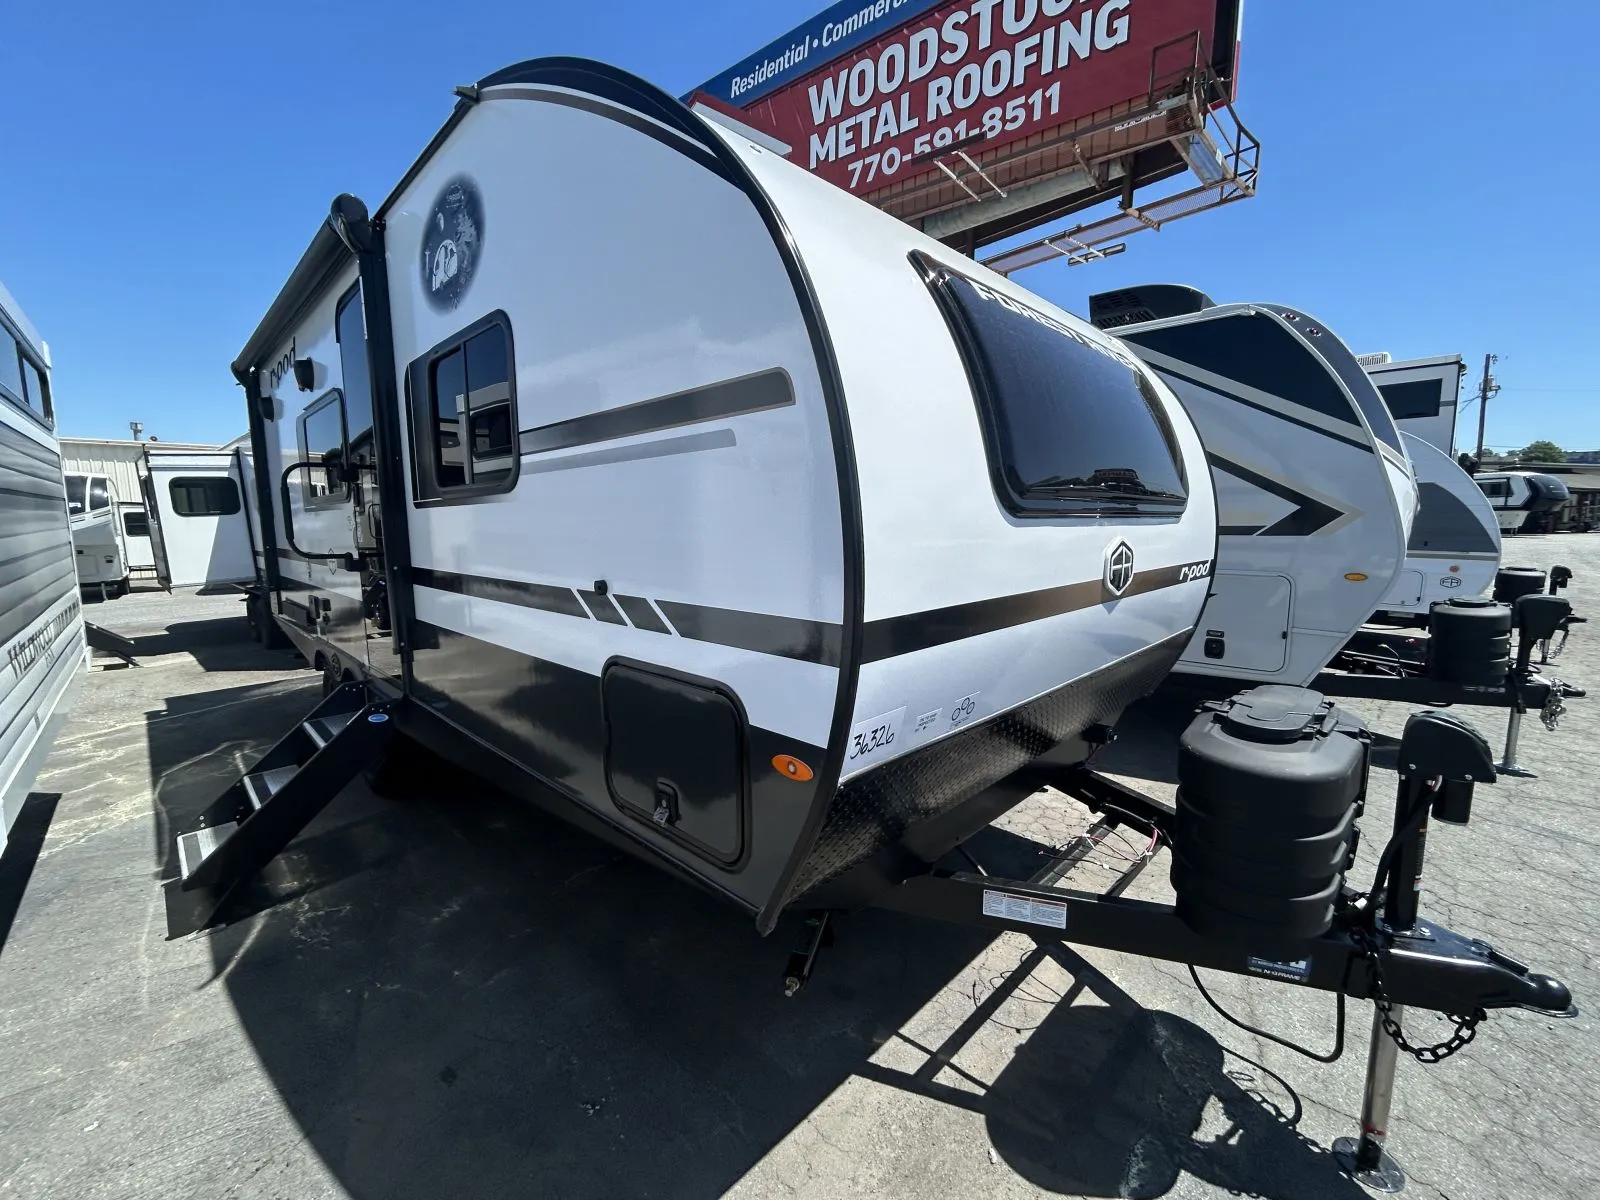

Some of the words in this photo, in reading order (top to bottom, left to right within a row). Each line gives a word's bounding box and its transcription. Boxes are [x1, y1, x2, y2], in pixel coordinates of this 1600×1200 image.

[731, 35, 809, 98] Residential
[808, 0, 1088, 125] WOODSTO
[809, 92, 919, 170] METAL
[927, 0, 1130, 122] ROOFING
[848, 81, 1061, 189] 770-591-8511
[965, 277, 1083, 345] FOREST
[850, 723, 895, 760] 36326
